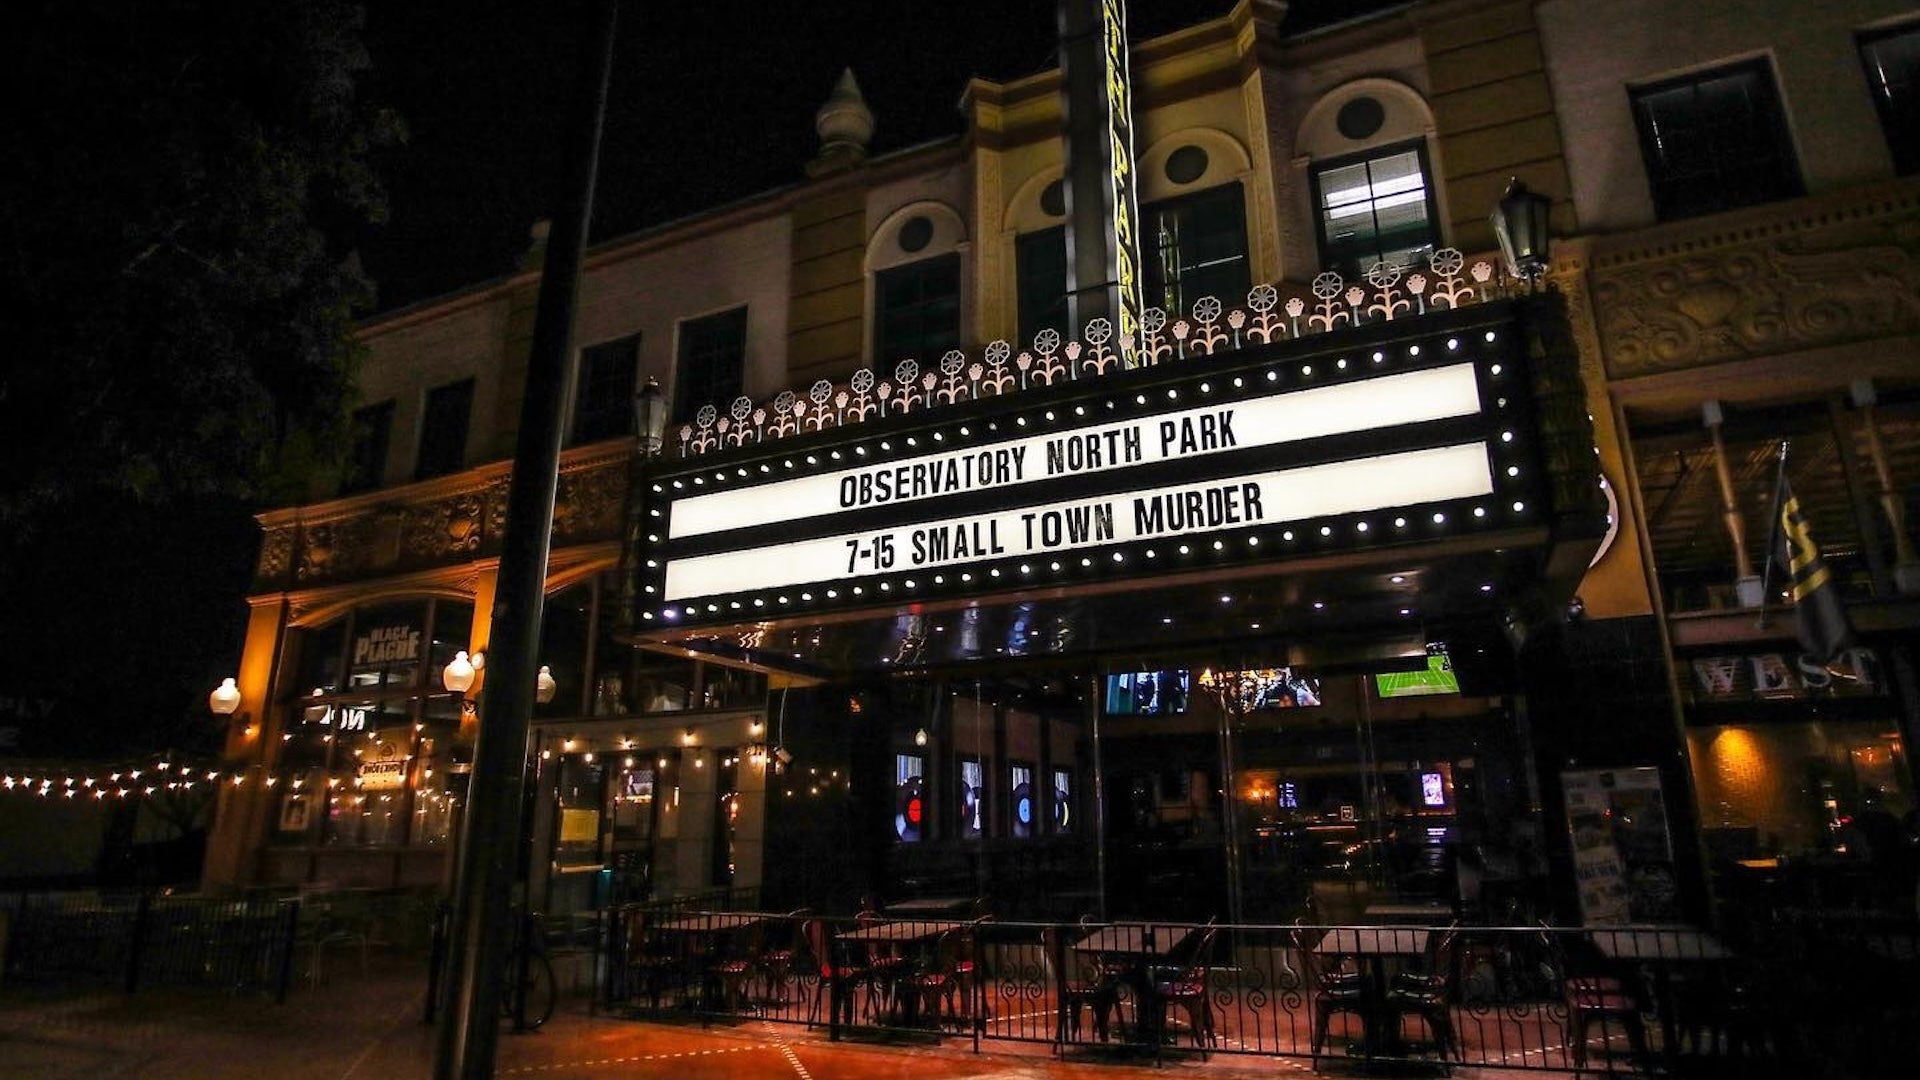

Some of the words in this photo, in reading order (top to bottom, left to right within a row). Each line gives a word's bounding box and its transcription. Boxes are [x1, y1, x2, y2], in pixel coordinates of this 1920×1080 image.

[840, 446, 1026, 508] OBSERVATORY
[1046, 426, 1142, 475] NORTH
[1160, 410, 1237, 457] PARK
[846, 534, 894, 573] 7-15
[912, 519, 1004, 565] SMALL
[1021, 503, 1114, 550] TOWN
[1133, 482, 1264, 536] MURDER
[354, 631, 421, 664] PLAGUE
[370, 625, 410, 642] BLACK
[1690, 647, 1878, 696] WEST
